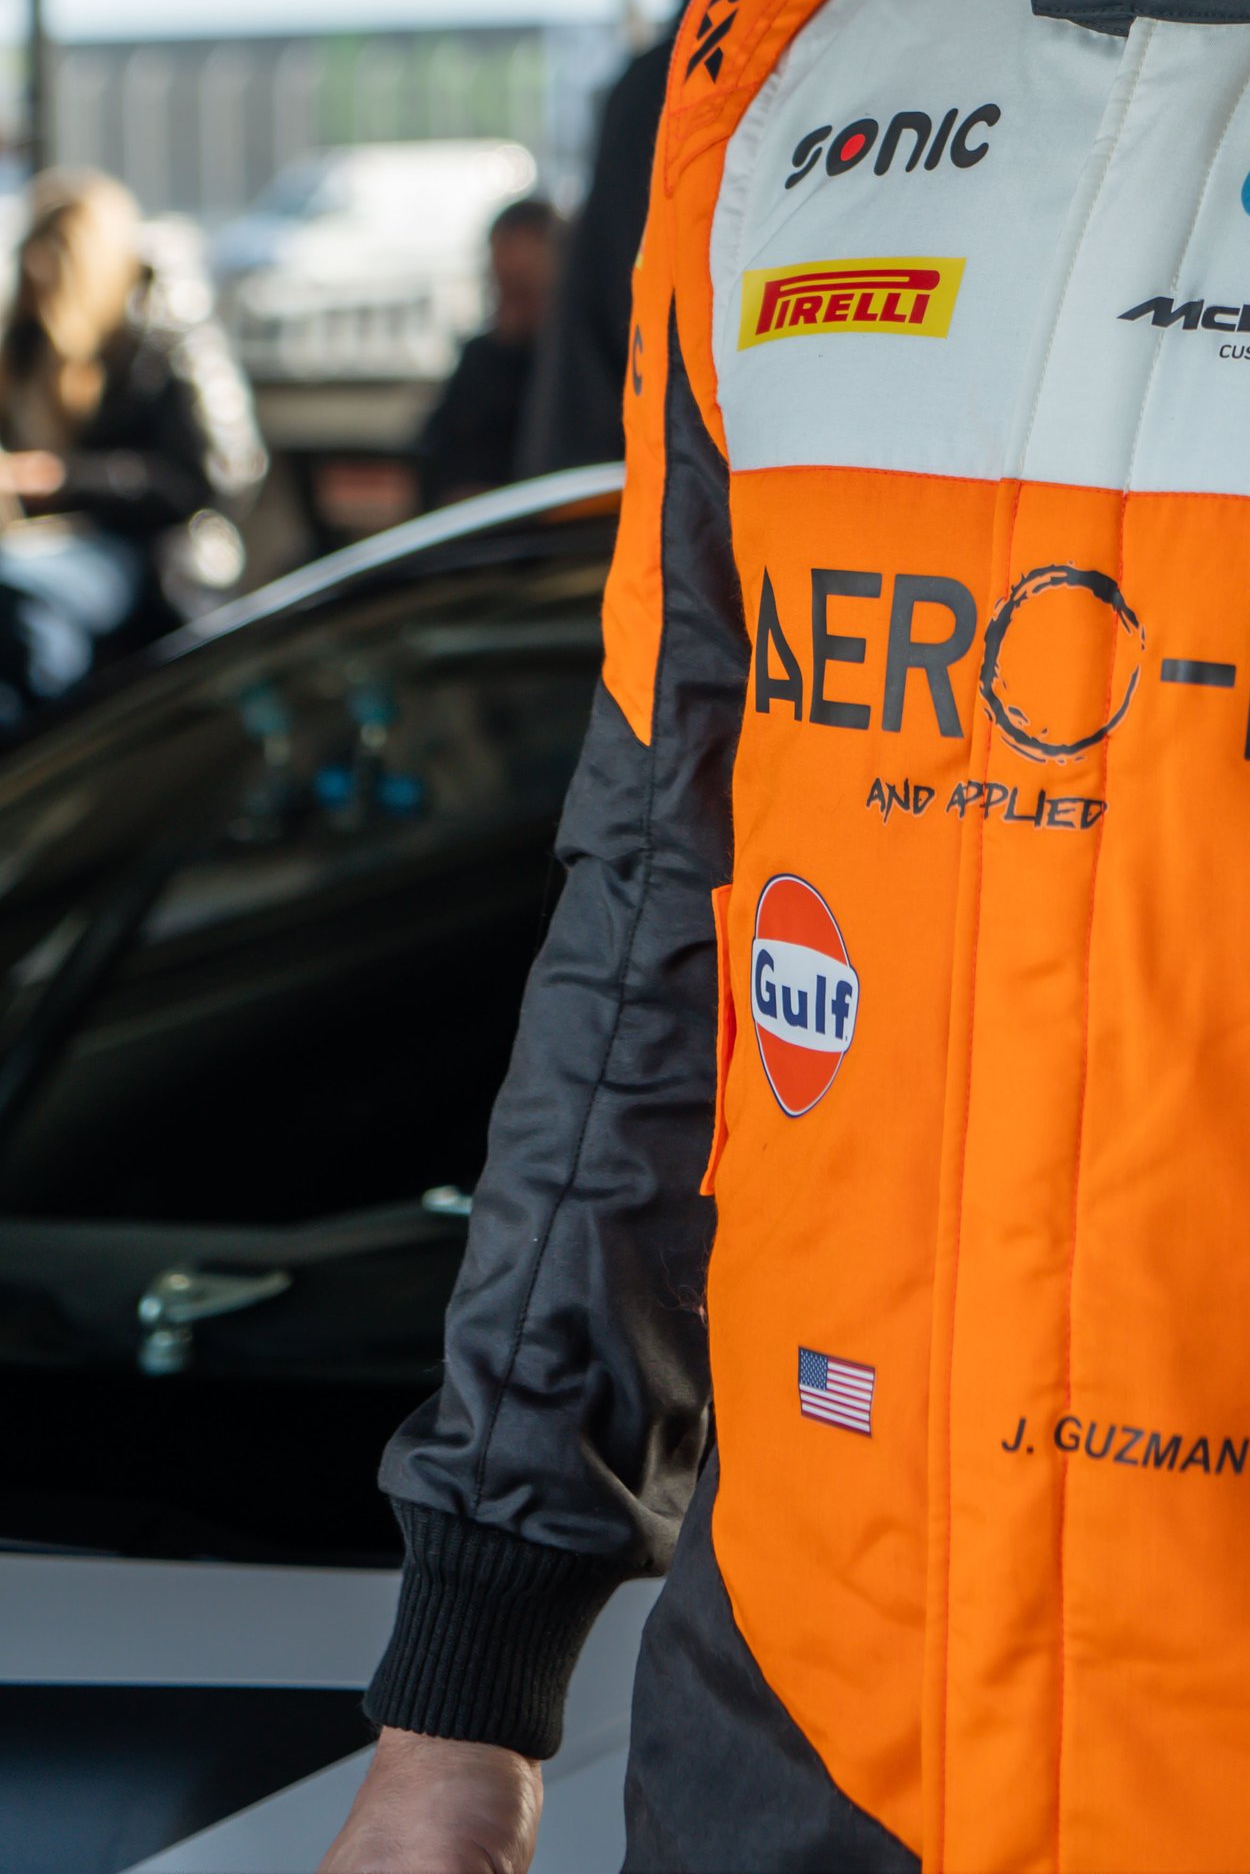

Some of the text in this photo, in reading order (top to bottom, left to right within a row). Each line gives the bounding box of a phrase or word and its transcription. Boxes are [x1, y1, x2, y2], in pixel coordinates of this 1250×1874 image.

[755, 269, 941, 336] PIRELLI
[865, 777, 1109, 830] AND APPLIED
[754, 947, 854, 1042] Gulf
[1001, 1415, 1250, 1477] J. GUZMAN
